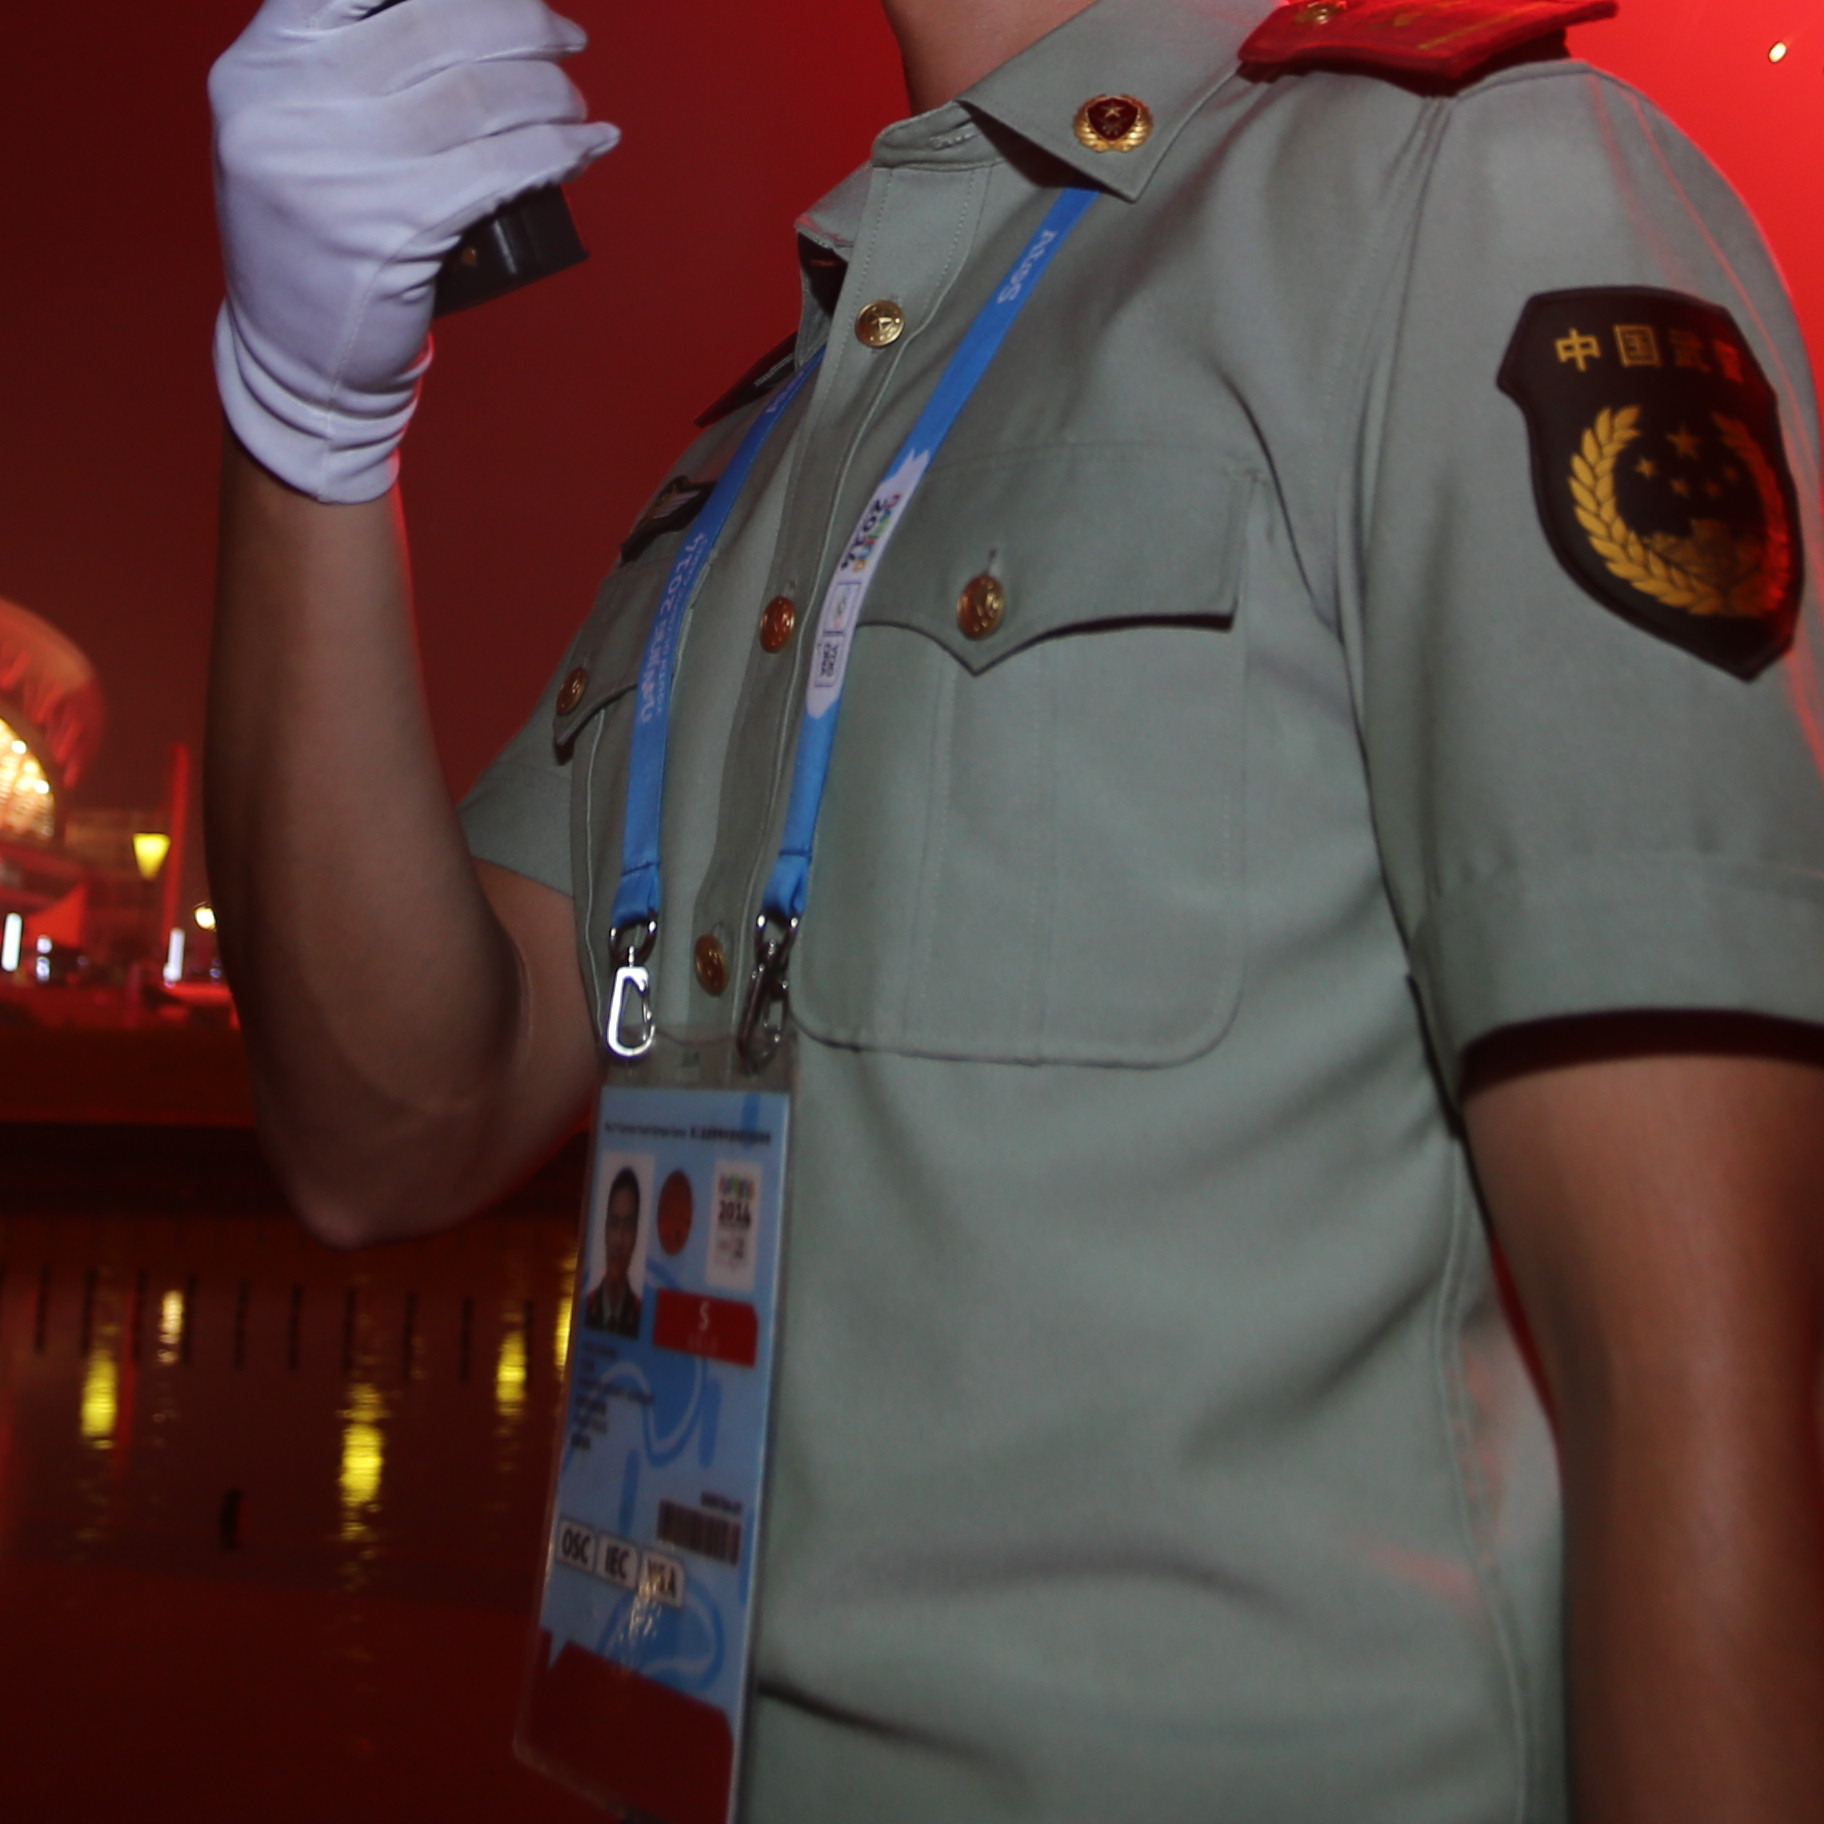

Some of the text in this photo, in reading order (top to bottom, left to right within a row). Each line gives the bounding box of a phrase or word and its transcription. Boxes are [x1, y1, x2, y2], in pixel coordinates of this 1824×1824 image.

[841, 500, 886, 570] 2014
[659, 531, 707, 616] 2014
[719, 1200, 751, 1226] 2014
[698, 1300, 710, 1332] S
[562, 1528, 591, 1564] OSC
[605, 1546, 629, 1580] IEC
